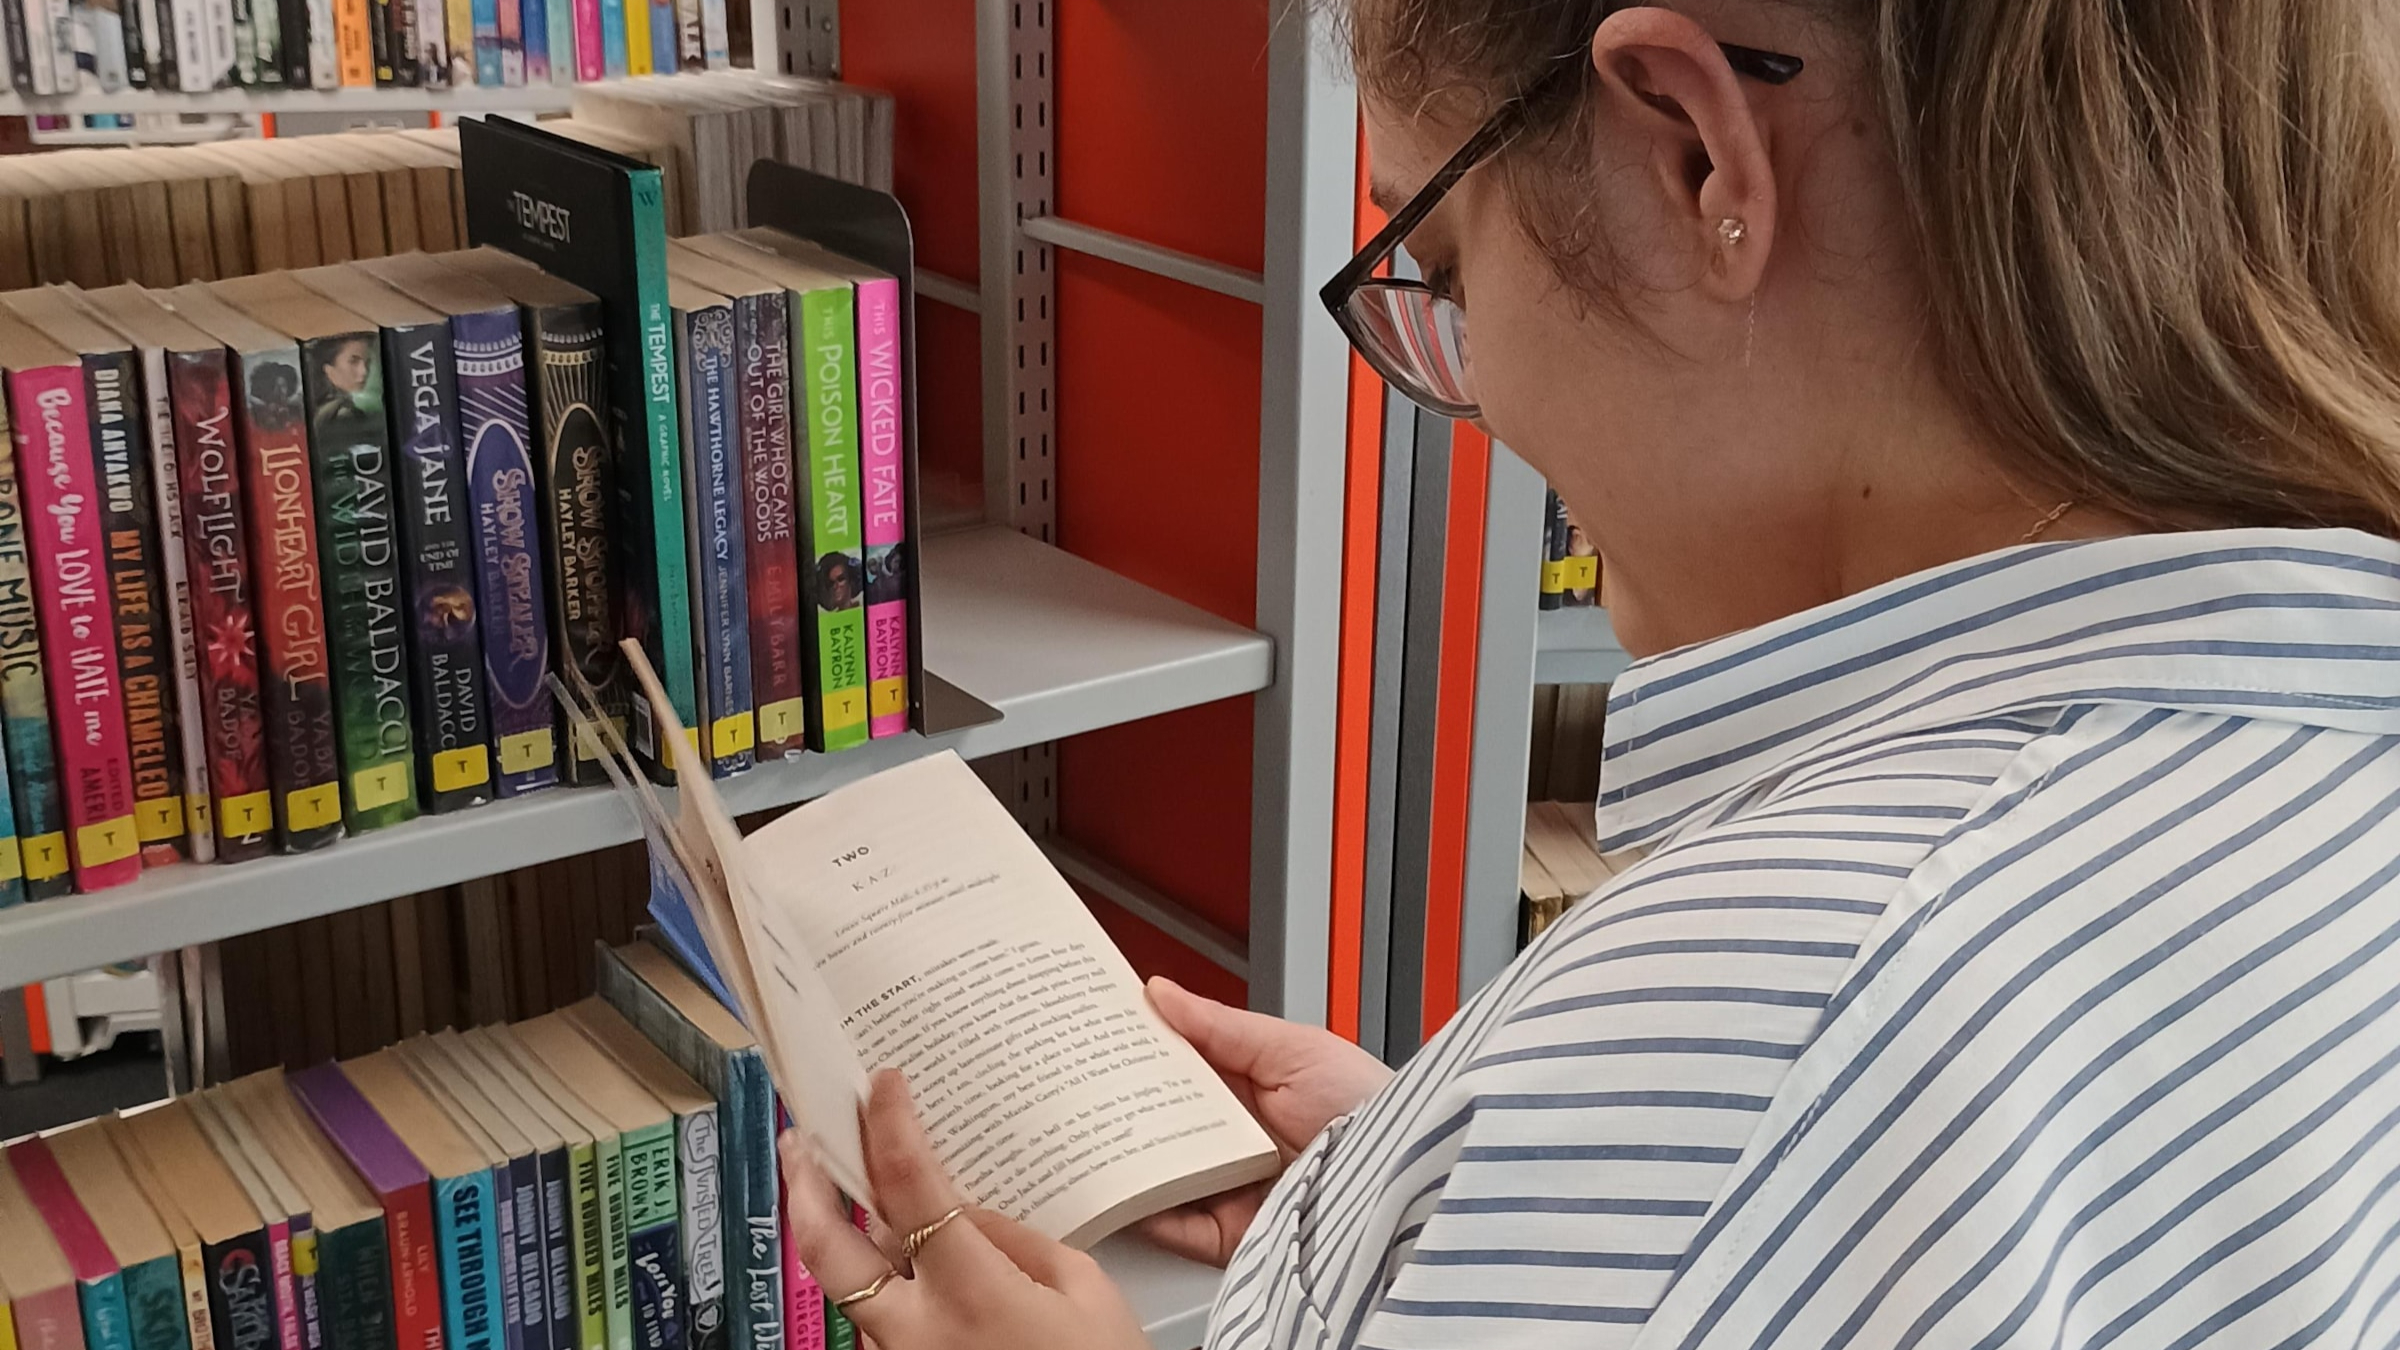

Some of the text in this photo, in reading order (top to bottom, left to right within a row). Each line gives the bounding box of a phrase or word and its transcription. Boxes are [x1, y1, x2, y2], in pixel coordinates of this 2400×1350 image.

[512, 190, 571, 243] TEMPEST
[649, 302, 662, 321] THE
[409, 340, 443, 434] VEGA
[649, 323, 671, 404] TEMPEST
[707, 355, 719, 386] THE
[36, 387, 72, 491] Because
[94, 368, 134, 513] DIANA ANYAKWO
[707, 387, 726, 498] HAWTHORNE
[765, 341, 790, 541] THE GIRL WHO CAME
[817, 306, 849, 537] THIS POISON HEART
[869, 301, 898, 529] THIS WICKED FATE
[747, 344, 773, 544] OUT OF THE WOODS
[350, 444, 391, 567] DAVID
[492, 467, 527, 549] SHOW
[713, 499, 729, 561] LEGACY
[481, 502, 500, 566] HAYLEY
[558, 487, 580, 622] HAYLEY BARKER
[55, 549, 97, 612] LOVE
[259, 444, 327, 702] LIONHEART GIRL
[1552, 572, 1560, 584] T
[1579, 566, 1588, 578] T
[1, 577, 39, 682] MUSIC
[70, 615, 94, 641] to
[722, 628, 734, 664] LYNN
[767, 565, 788, 688] EMILY BARR
[842, 623, 856, 686] KALYNN
[875, 618, 889, 680] BAYRON
[888, 615, 901, 677] KALYNN
[70, 645, 110, 706] HATE
[110, 529, 170, 798] MY LIFE AS A CHAMELEO
[363, 577, 408, 756] BALDACCI
[829, 627, 843, 691] BAYRON
[432, 652, 458, 748] BALDACC
[455, 667, 478, 733] DAVID
[778, 711, 788, 726] T
[842, 700, 852, 715] T
[889, 687, 900, 702] T
[84, 710, 104, 747] me
[313, 709, 334, 778] YABA
[522, 742, 534, 759] T
[730, 729, 739, 744] T
[80, 766, 107, 823] AMERI
[376, 776, 388, 792] T
[457, 759, 469, 774] T
[158, 808, 171, 824] T
[195, 805, 207, 821] T
[243, 807, 254, 822] T
[310, 798, 322, 813] T
[41, 847, 53, 862] T
[103, 830, 116, 847] T
[832, 846, 869, 867] TWO
[852, 931, 868, 946] and
[854, 998, 880, 1017] THE
[880, 975, 922, 1001] START,
[923, 957, 958, 977] mistakes
[871, 975, 959, 1026] believe you're making
[899, 1014, 919, 1029] their
[921, 1001, 942, 1015] right
[943, 986, 966, 1003] mind
[930, 1017, 947, 1030] you
[944, 1004, 969, 1019] know
[970, 987, 1007, 1007] anything
[985, 1071, 1021, 1091] looking
[1016, 1081, 1036, 1093] best
[1036, 1066, 1063, 1083] friend
[983, 1120, 1003, 1134] with
[1002, 1100, 1035, 1121] Mariah
[630, 1151, 651, 1221] BROWN
[652, 1146, 671, 1193] ERIK
[453, 1183, 481, 1229] SEE
[605, 1153, 630, 1311] FIVE HUNDRED MILES
[746, 1204, 779, 1260] The
[416, 1245, 430, 1273] LILY
[578, 1160, 603, 1317] FIVE HUNDRED MILES
[456, 1228, 489, 1338] THROUGH
[746, 1266, 780, 1314] Lost
